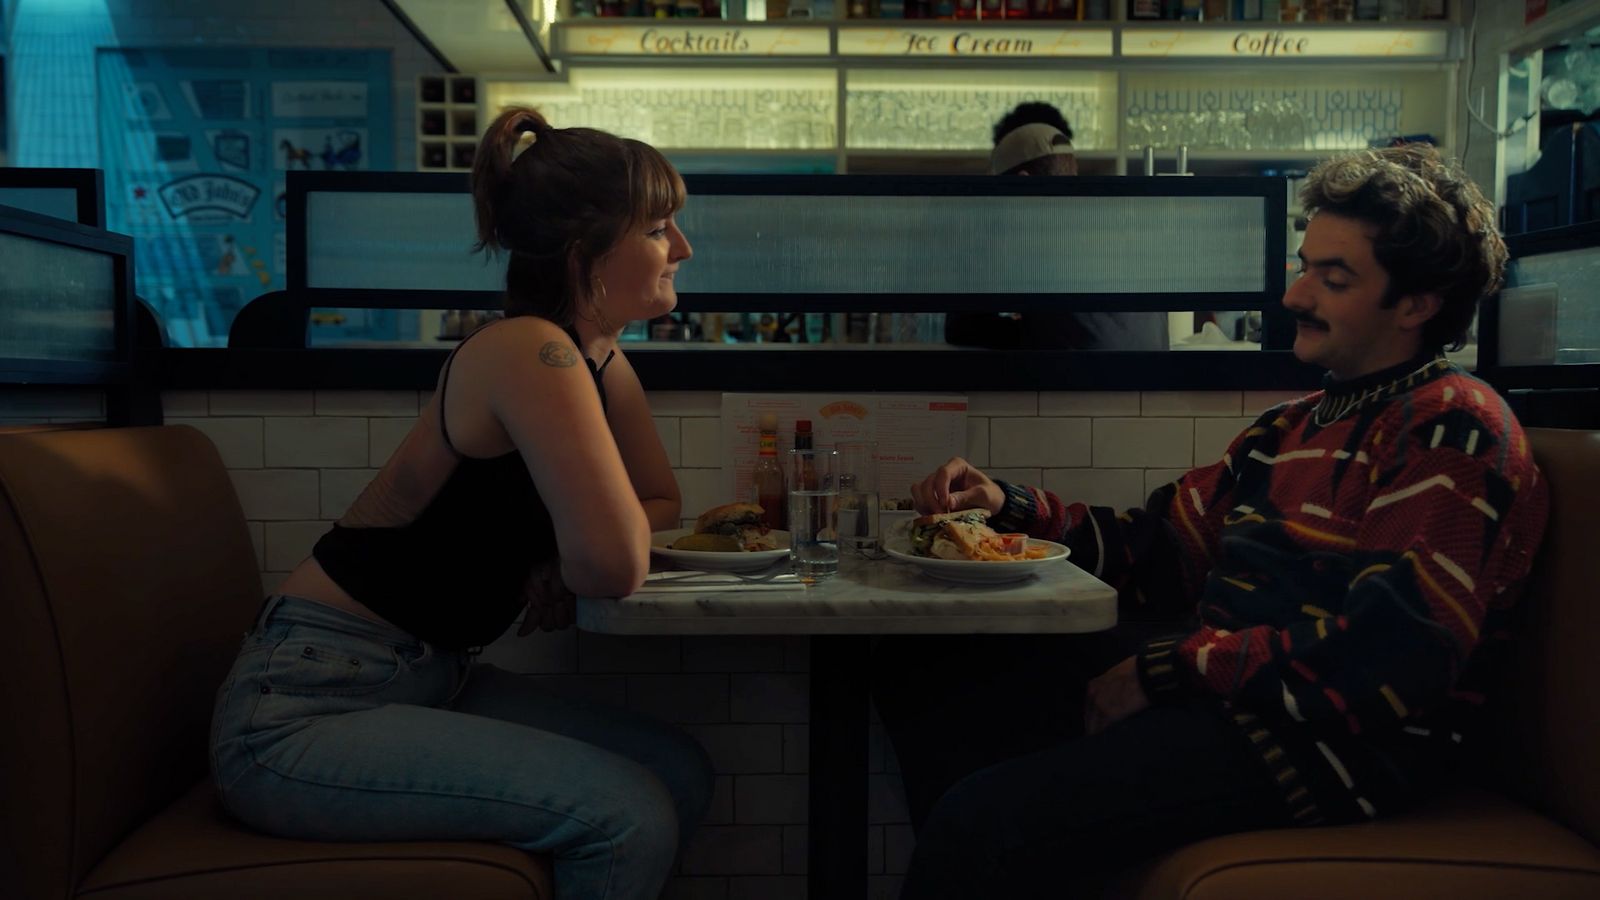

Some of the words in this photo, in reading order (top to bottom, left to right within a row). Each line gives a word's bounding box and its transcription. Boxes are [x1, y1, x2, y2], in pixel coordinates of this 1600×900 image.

[640, 27, 749, 52] Cocktails
[953, 30, 1033, 53] Cream
[1233, 31, 1309, 56] Coffee
